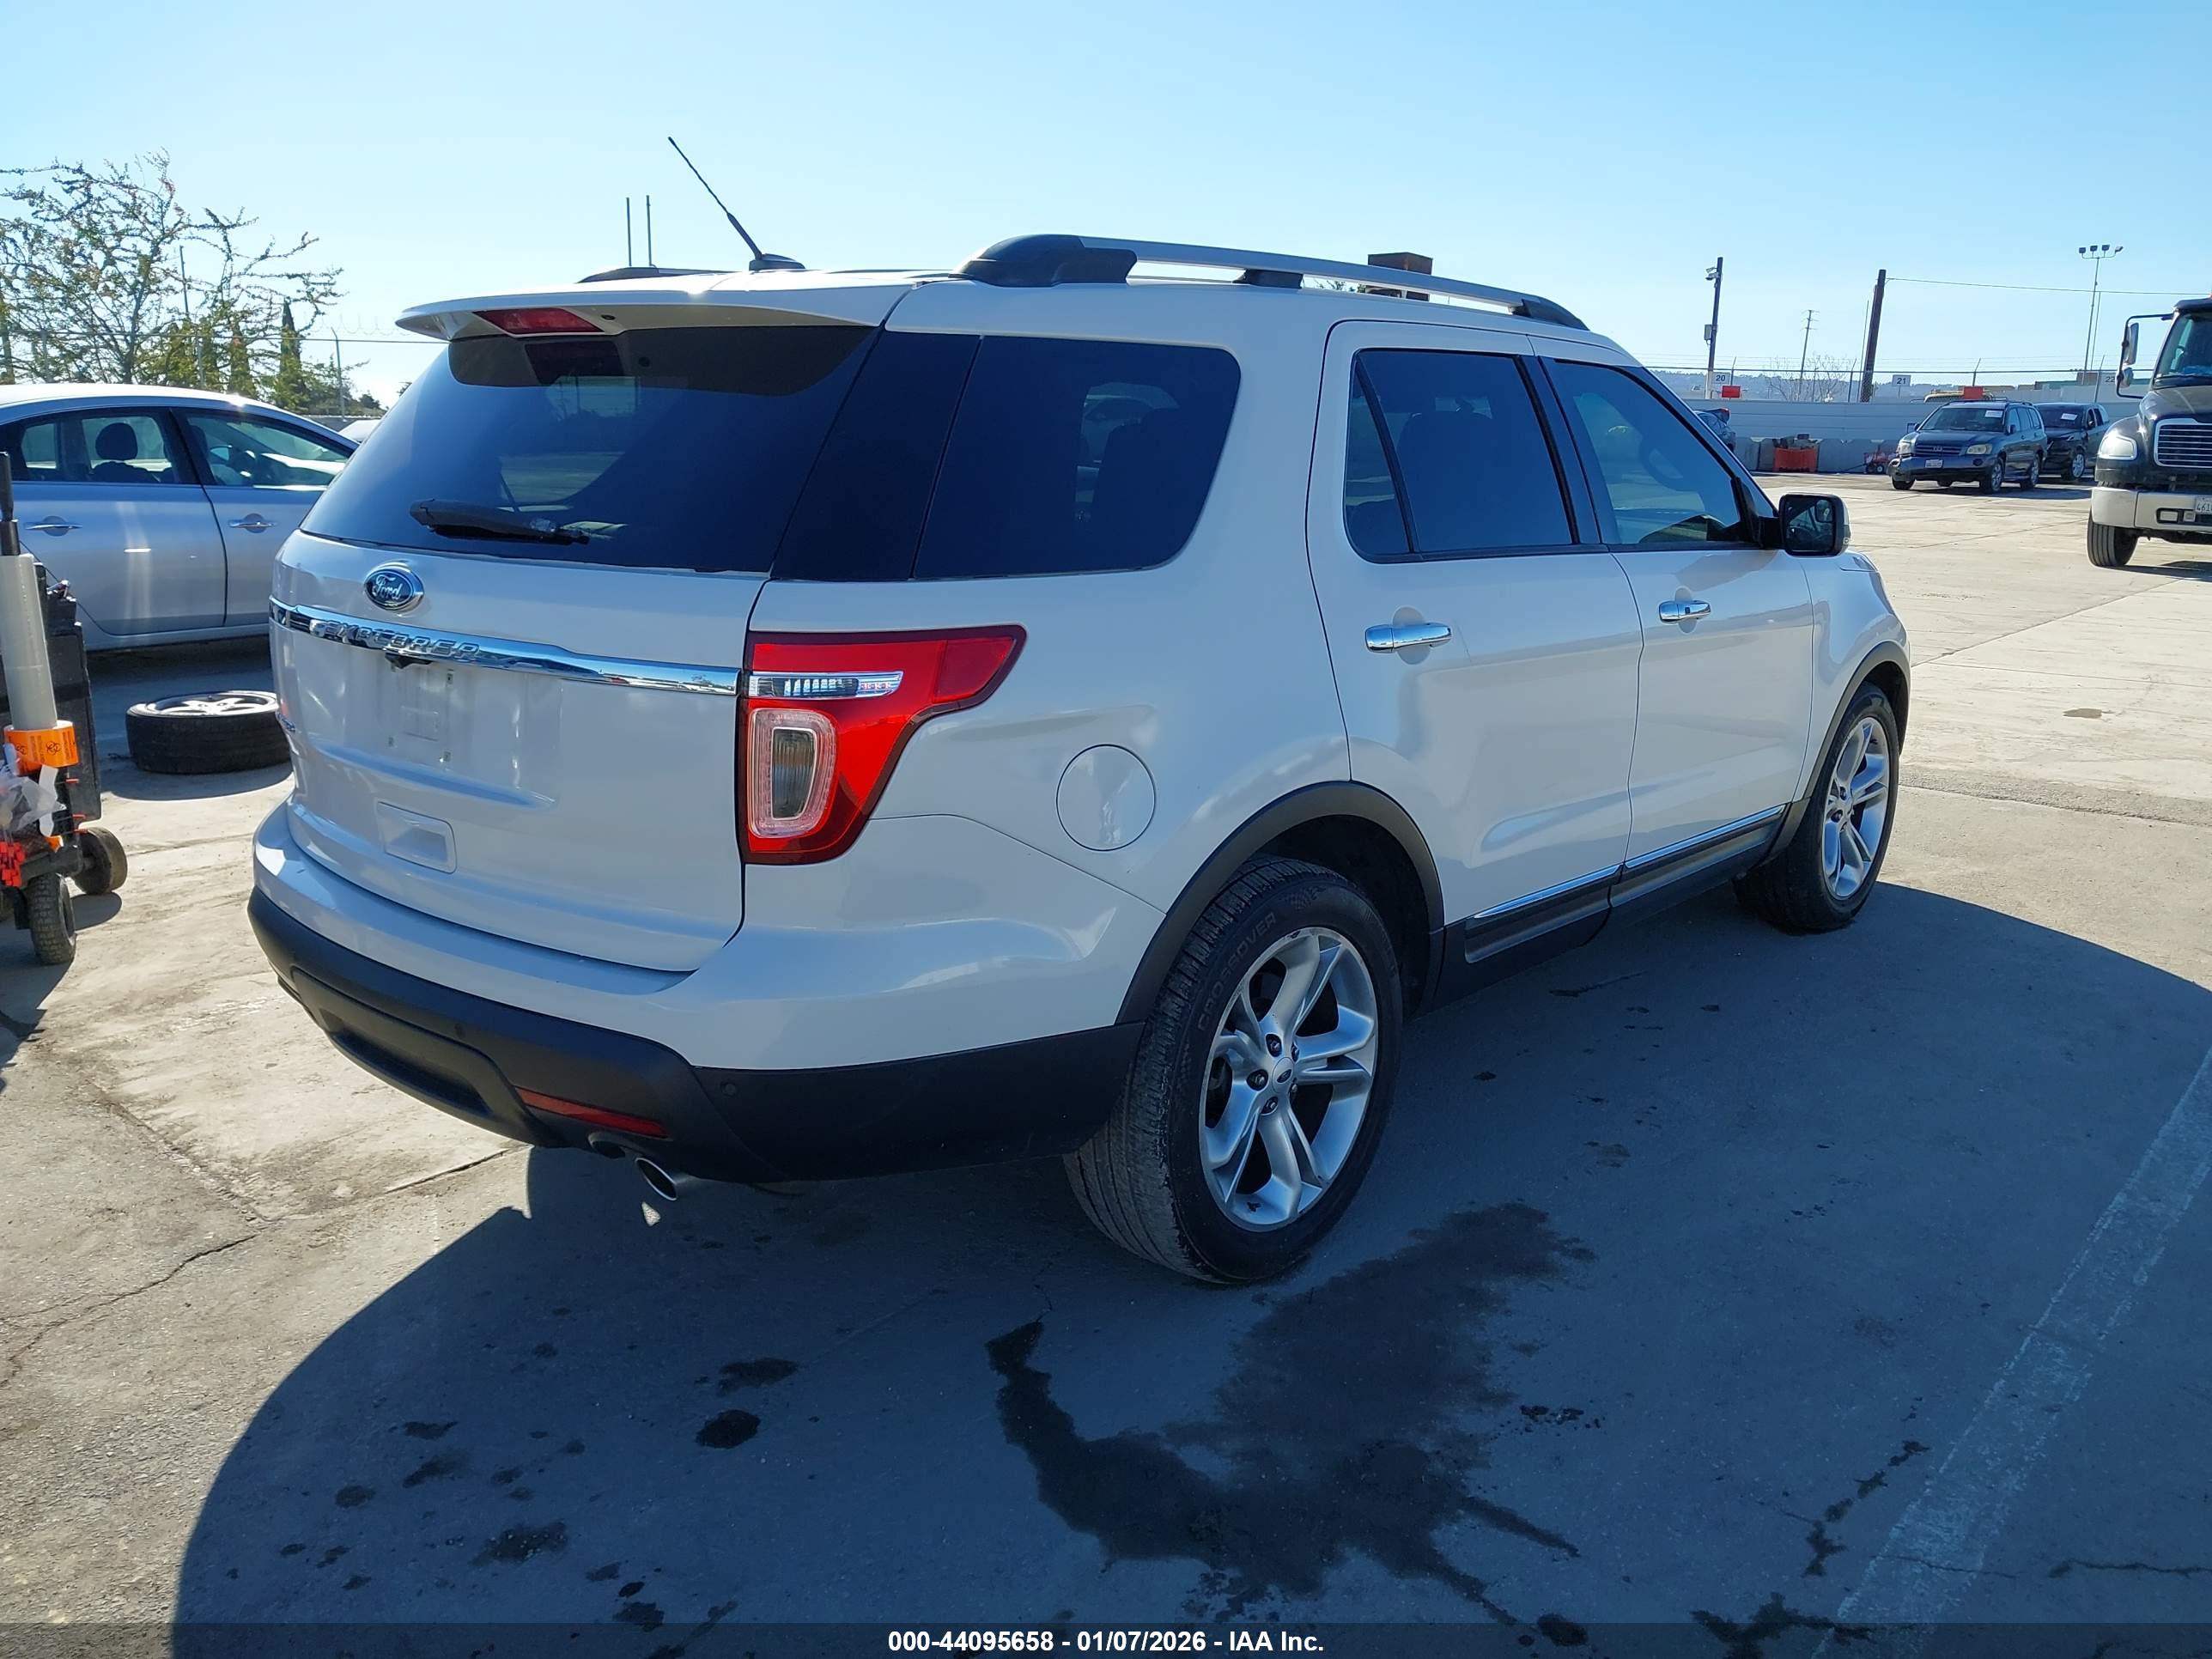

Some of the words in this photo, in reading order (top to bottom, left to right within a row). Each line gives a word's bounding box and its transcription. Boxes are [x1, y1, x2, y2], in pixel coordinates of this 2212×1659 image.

[372, 574, 403, 600] Ford
[322, 619, 480, 663] EXPLORER
[1197, 911, 1277, 1030] CROSSOVER
